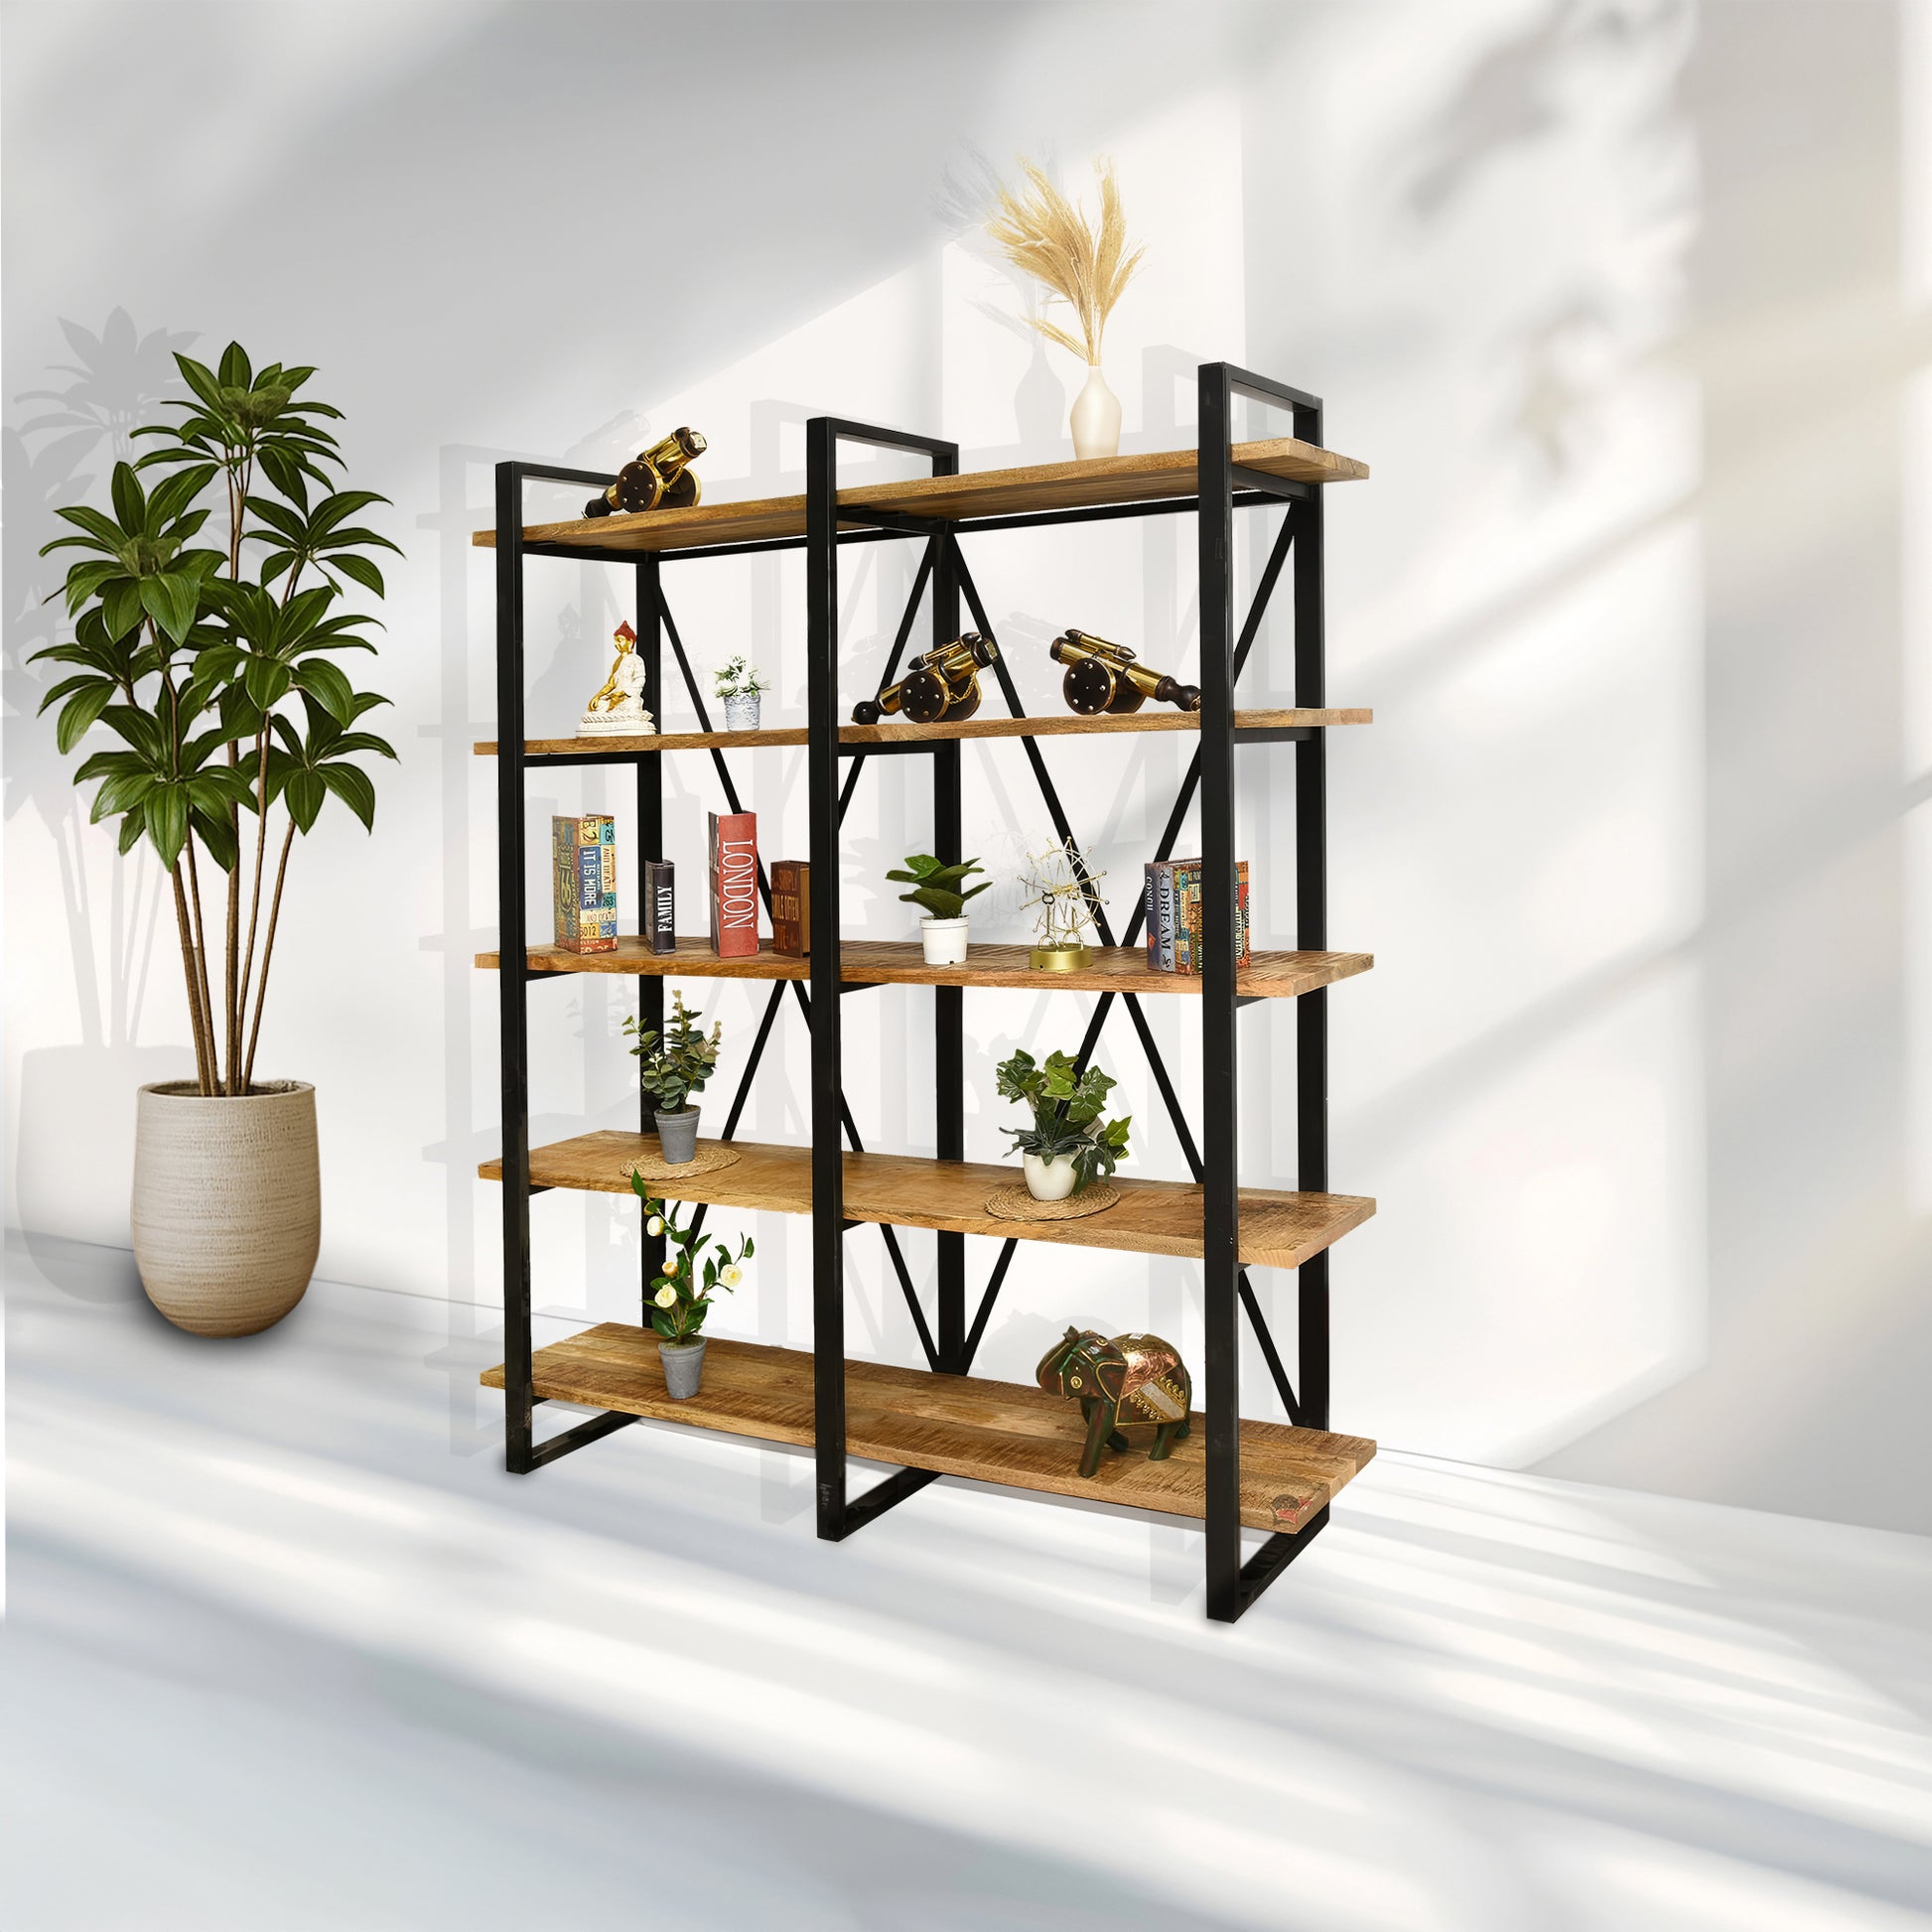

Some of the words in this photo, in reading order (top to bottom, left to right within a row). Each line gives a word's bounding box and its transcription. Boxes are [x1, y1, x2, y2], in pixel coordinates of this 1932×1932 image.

[583, 850, 596, 862] IT
[584, 864, 596, 876] IS
[584, 878, 597, 905] MORE
[722, 839, 755, 929] LONDON
[657, 885, 672, 933] FAMILY
[1160, 888, 1171, 950] DREAM
